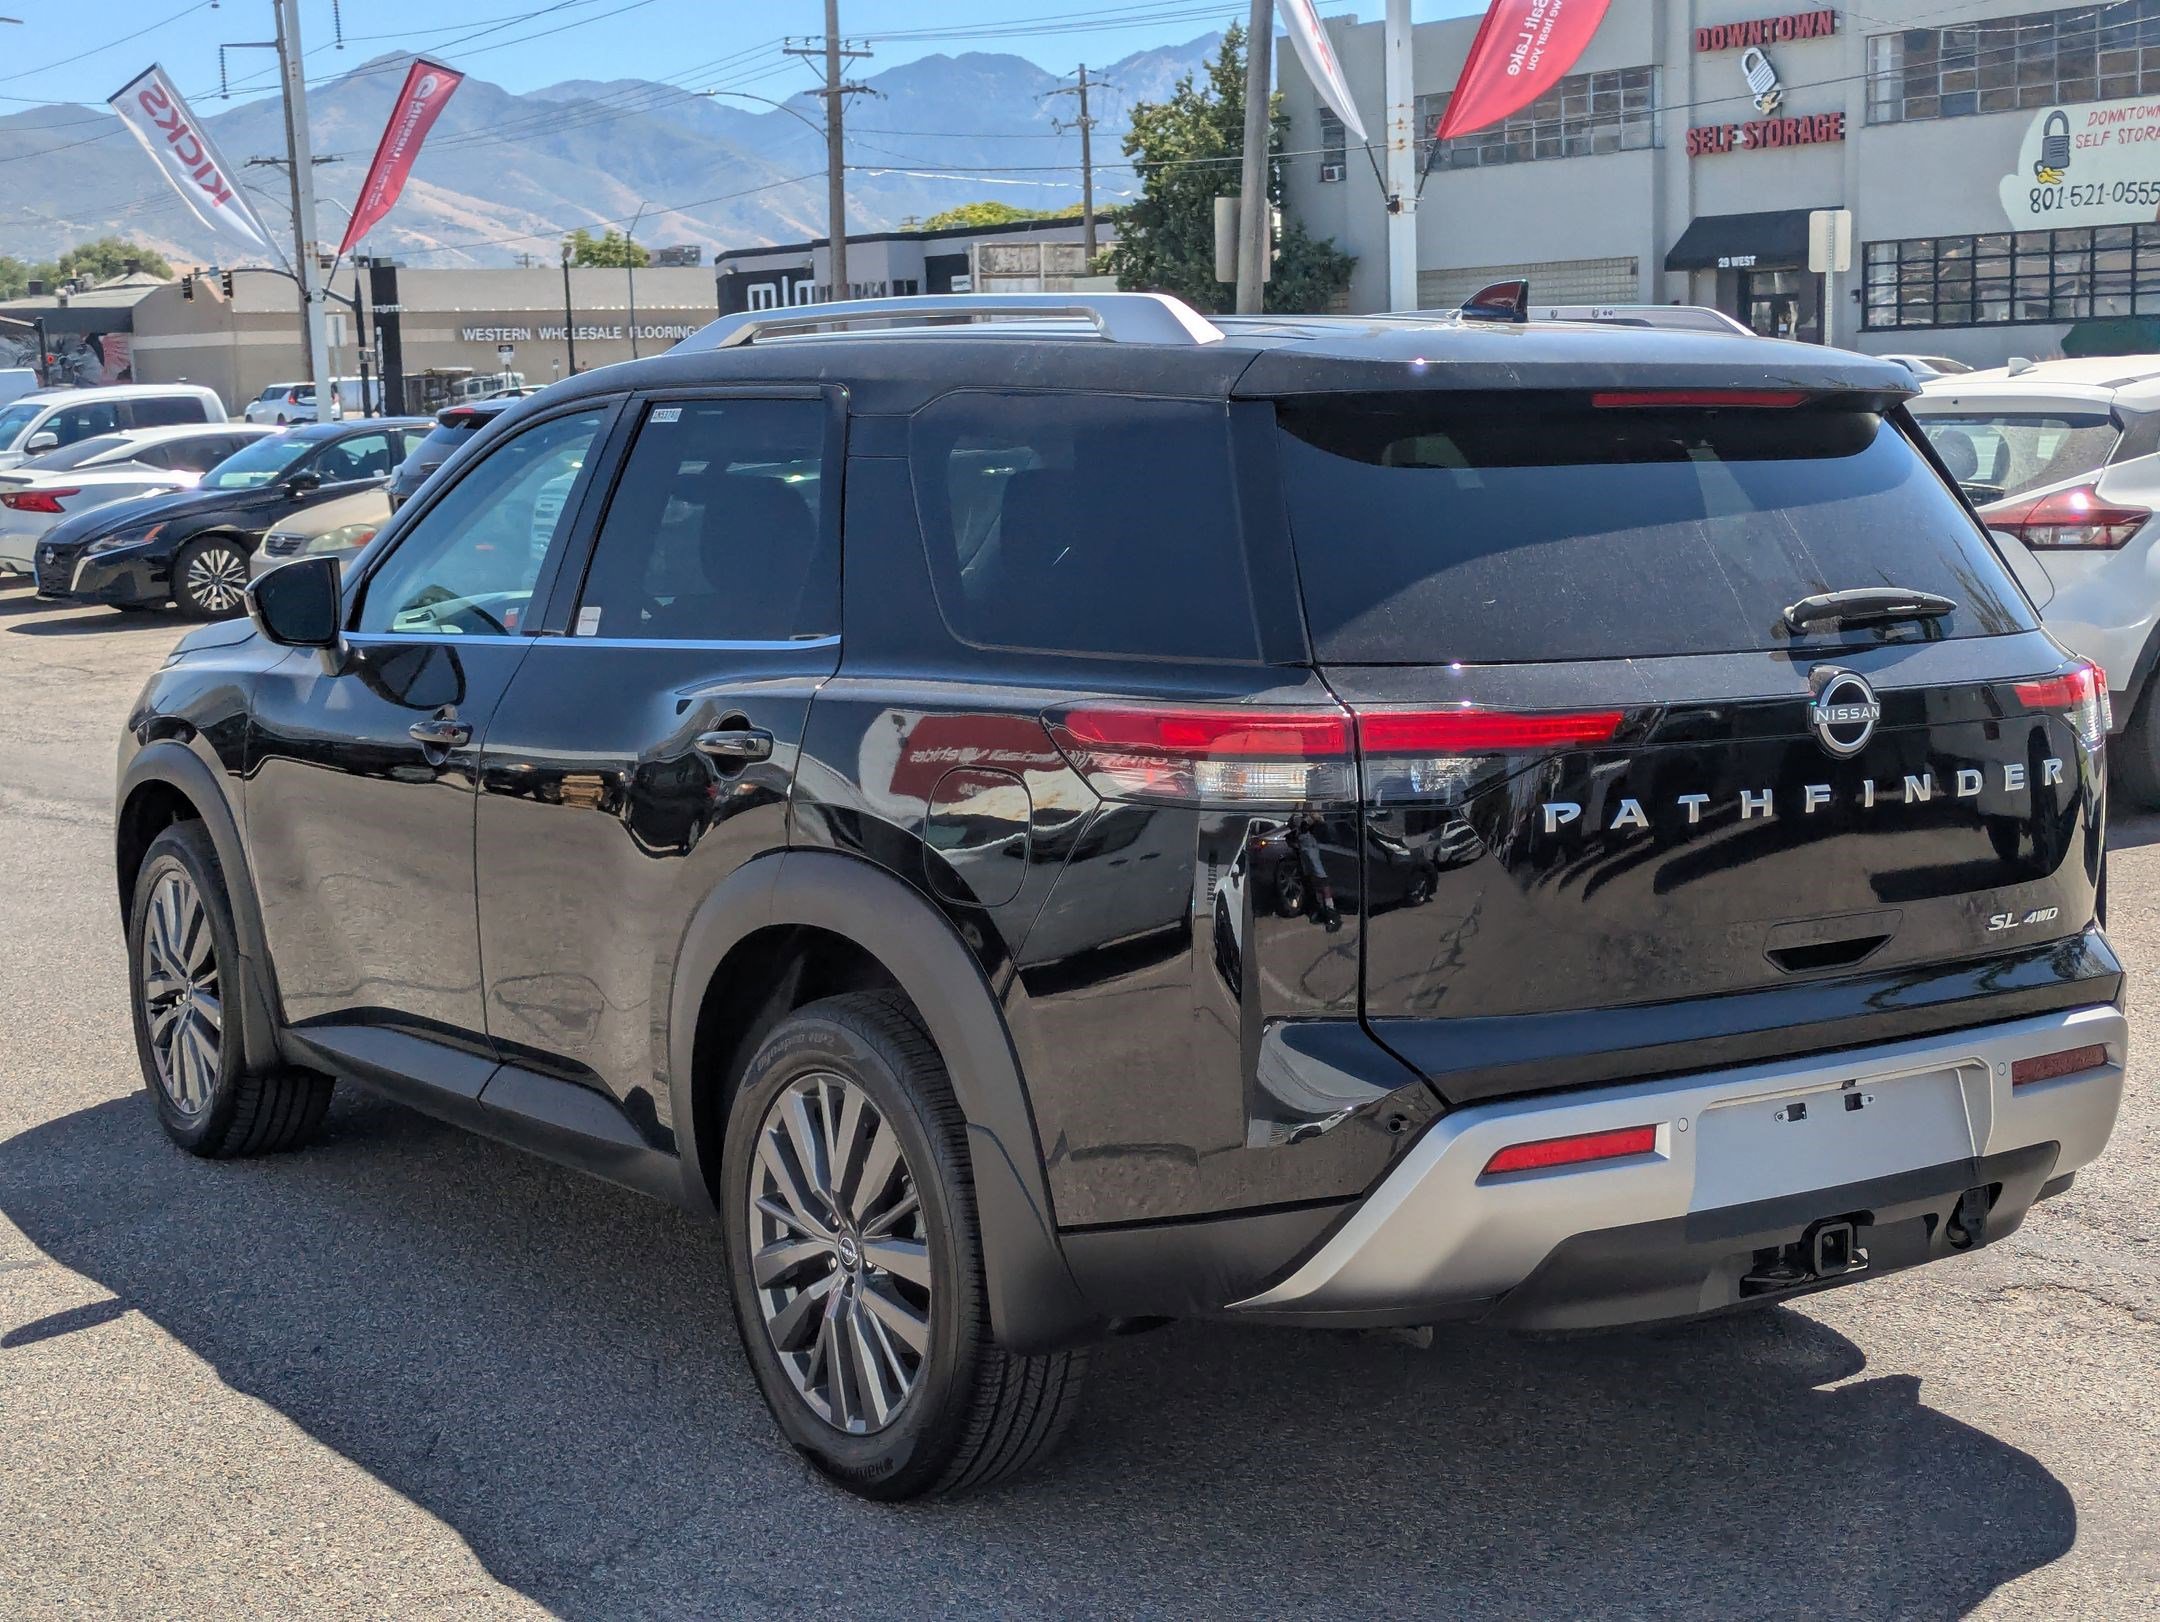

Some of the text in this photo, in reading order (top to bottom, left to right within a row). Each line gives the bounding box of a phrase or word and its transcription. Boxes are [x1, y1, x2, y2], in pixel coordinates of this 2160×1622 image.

[1695, 10, 1836, 52] DOWNTOWN
[1685, 112, 1846, 157] SELF STORAGE
[2075, 131, 2111, 149] SELF
[2029, 181, 2160, 214] 801-521-0555
[1730, 255, 1757, 267] WEST
[462, 325, 698, 342] WESTERN WHOLESALE FLOORING
[1816, 706, 1880, 722] NISSAN
[1543, 757, 2064, 834] PATHFINDER
[1987, 906, 2059, 931] SL 4WD
